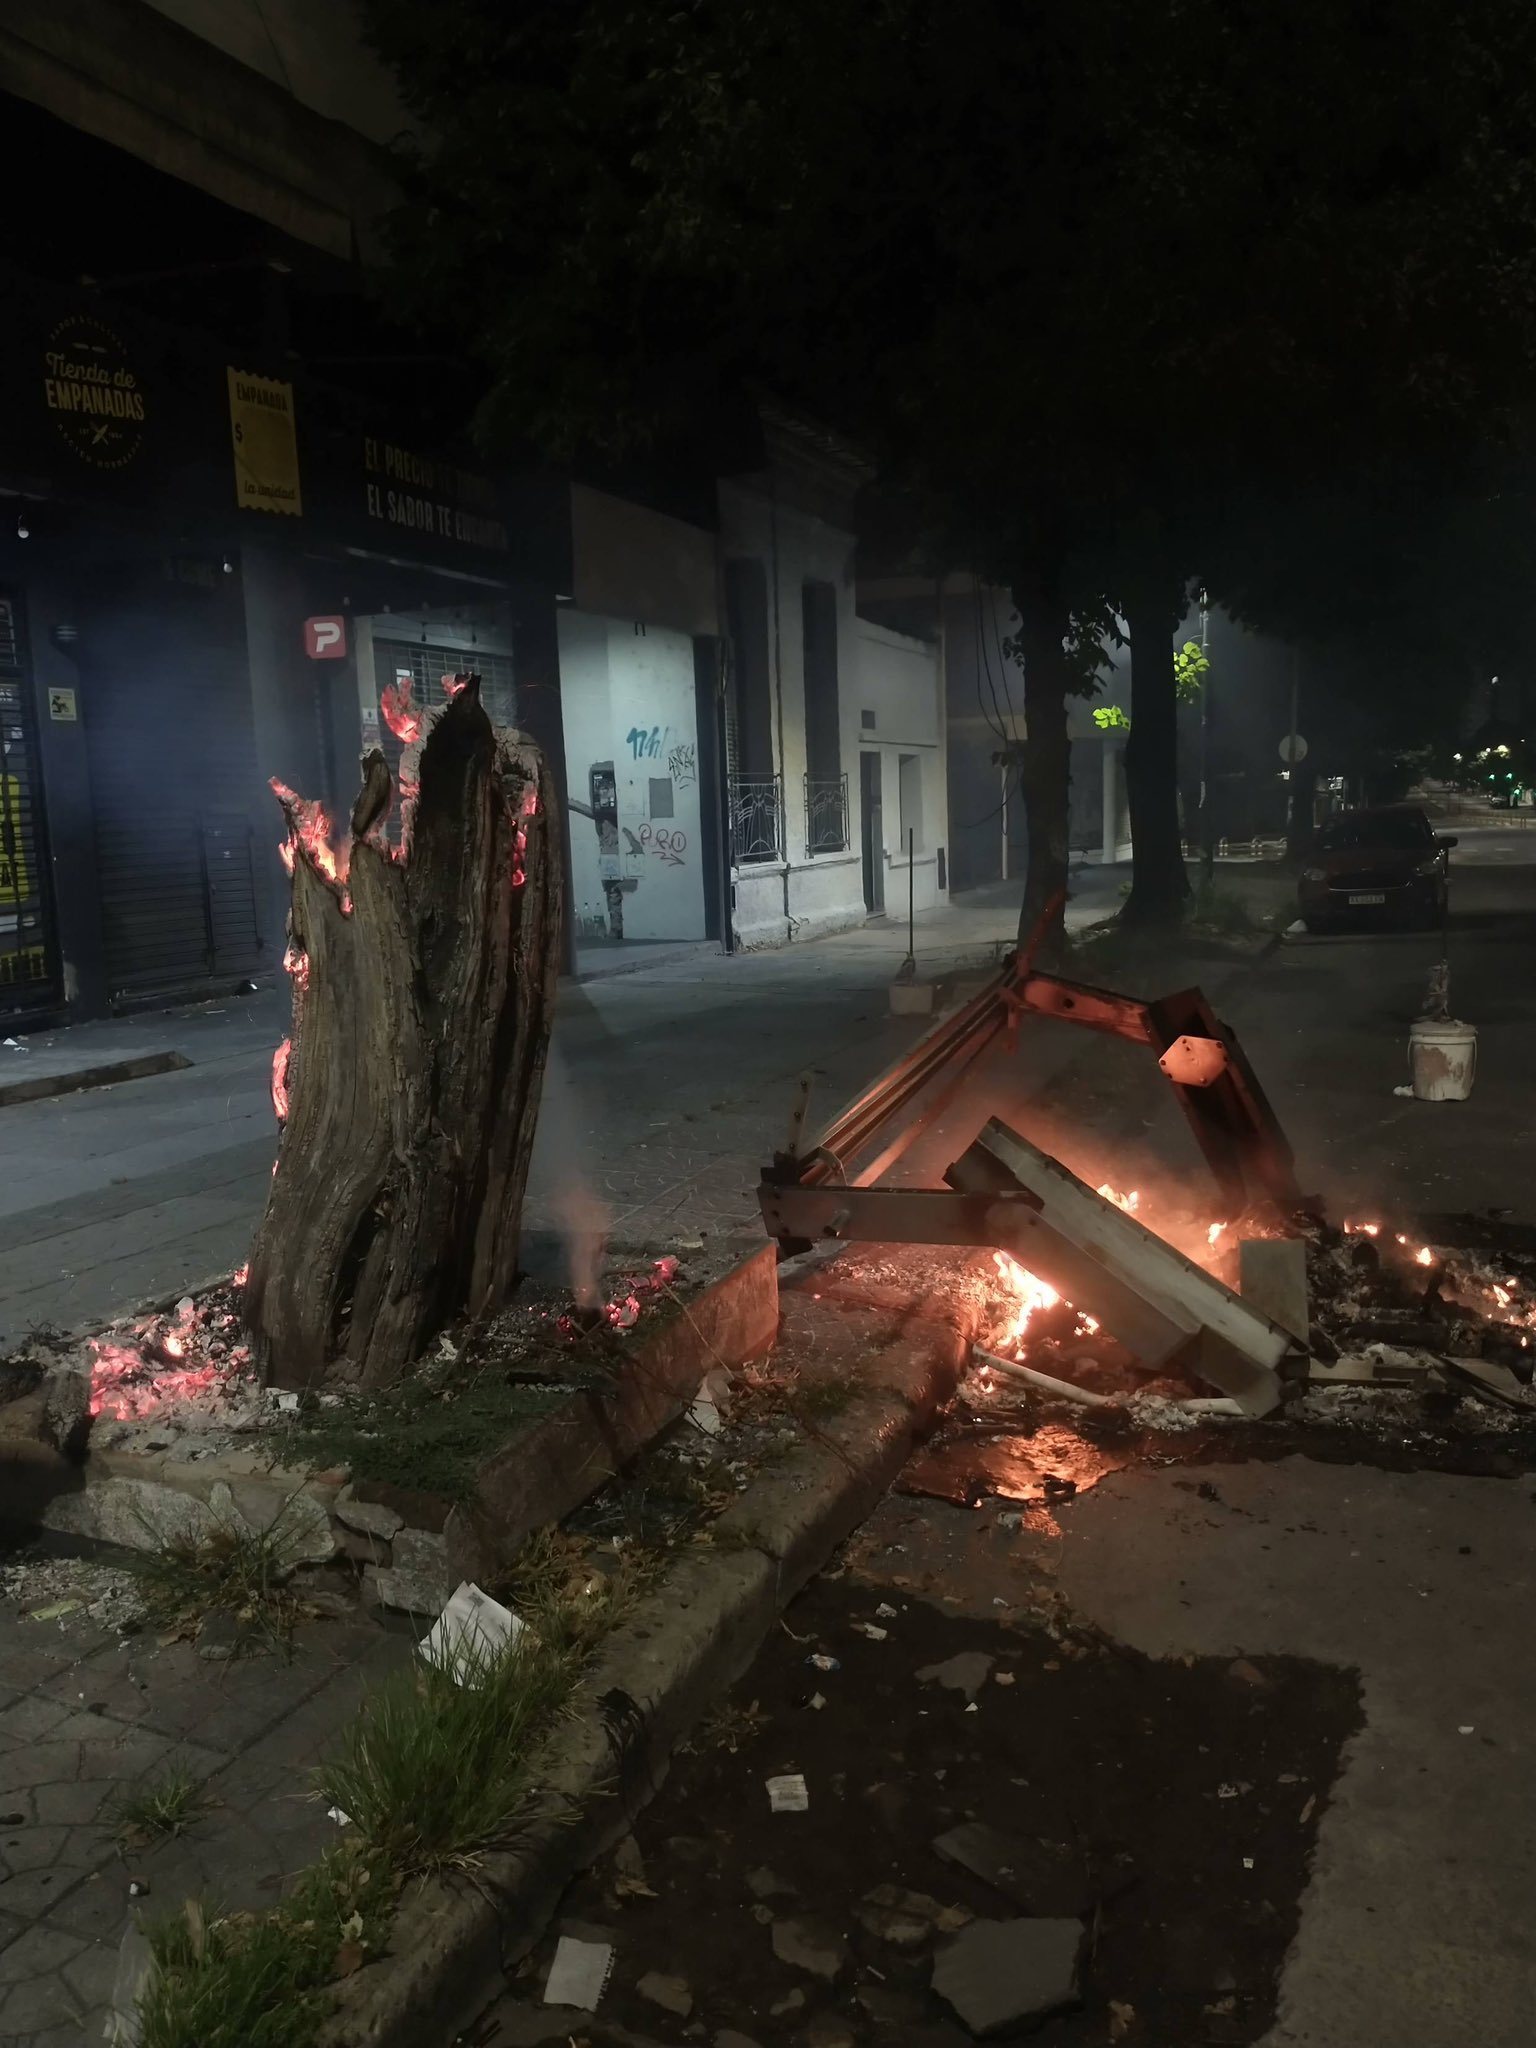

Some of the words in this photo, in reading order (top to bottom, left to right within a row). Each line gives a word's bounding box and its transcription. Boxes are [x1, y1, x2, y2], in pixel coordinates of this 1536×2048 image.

[45, 352, 112, 385] Tienda
[113, 367, 136, 389] de
[44, 378, 145, 421] EMPANADAS
[236, 382, 288, 411] EMPANADA
[364, 436, 380, 472] EL
[367, 482, 384, 519] EL
[386, 489, 434, 533] SABOR
[435, 504, 452, 537] TE
